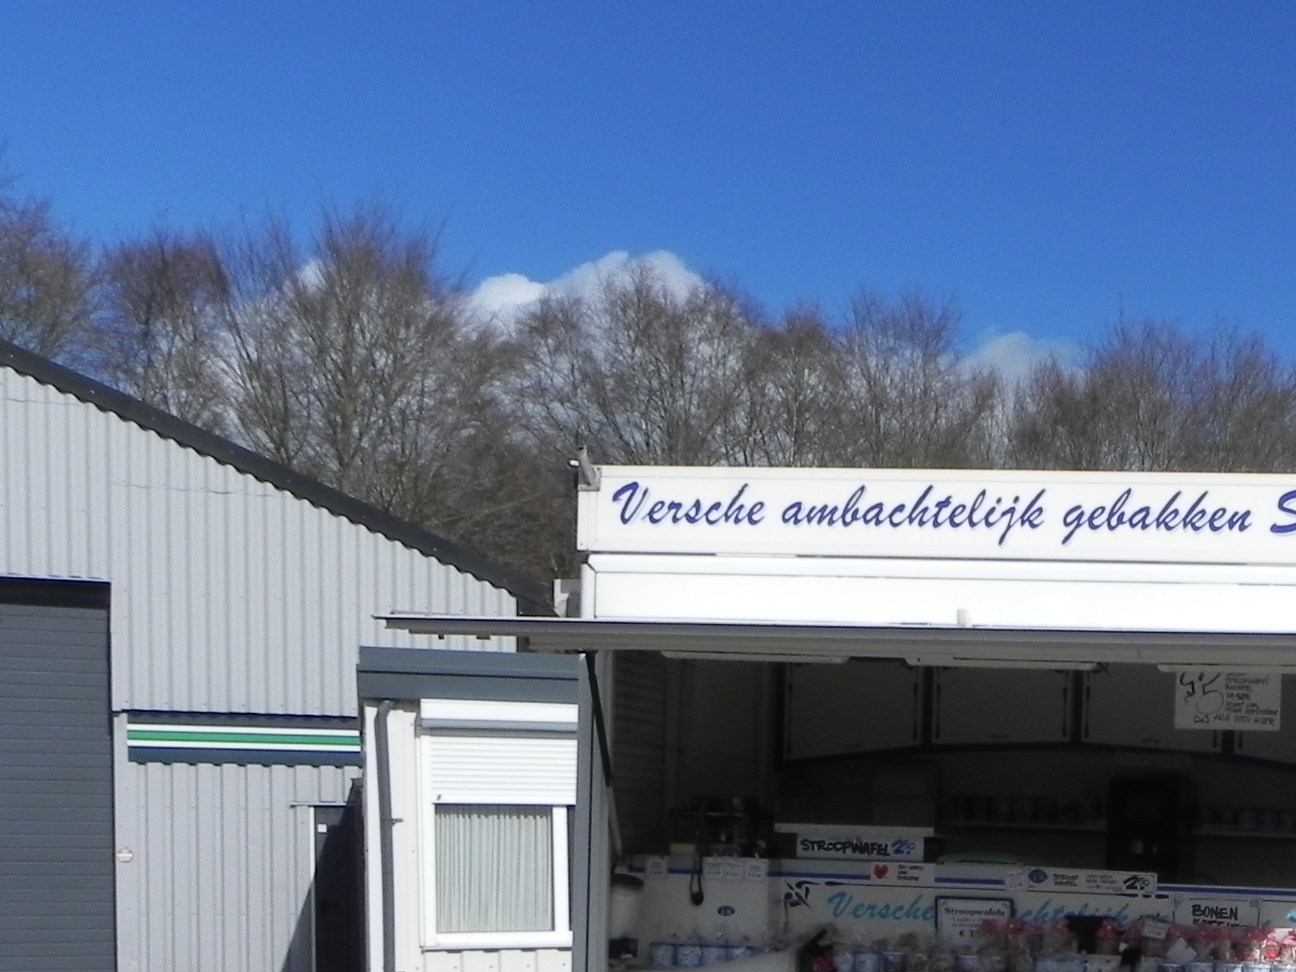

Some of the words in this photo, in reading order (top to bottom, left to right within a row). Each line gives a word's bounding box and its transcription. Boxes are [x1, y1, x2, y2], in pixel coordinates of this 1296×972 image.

[613, 482, 765, 526] Versche
[783, 484, 1045, 545] ambachtelijk
[1062, 488, 1251, 546] gebakken
[801, 839, 889, 856] STROOPWAFEL
[828, 891, 935, 921] Versche
[1192, 904, 1238, 921] BONEN
